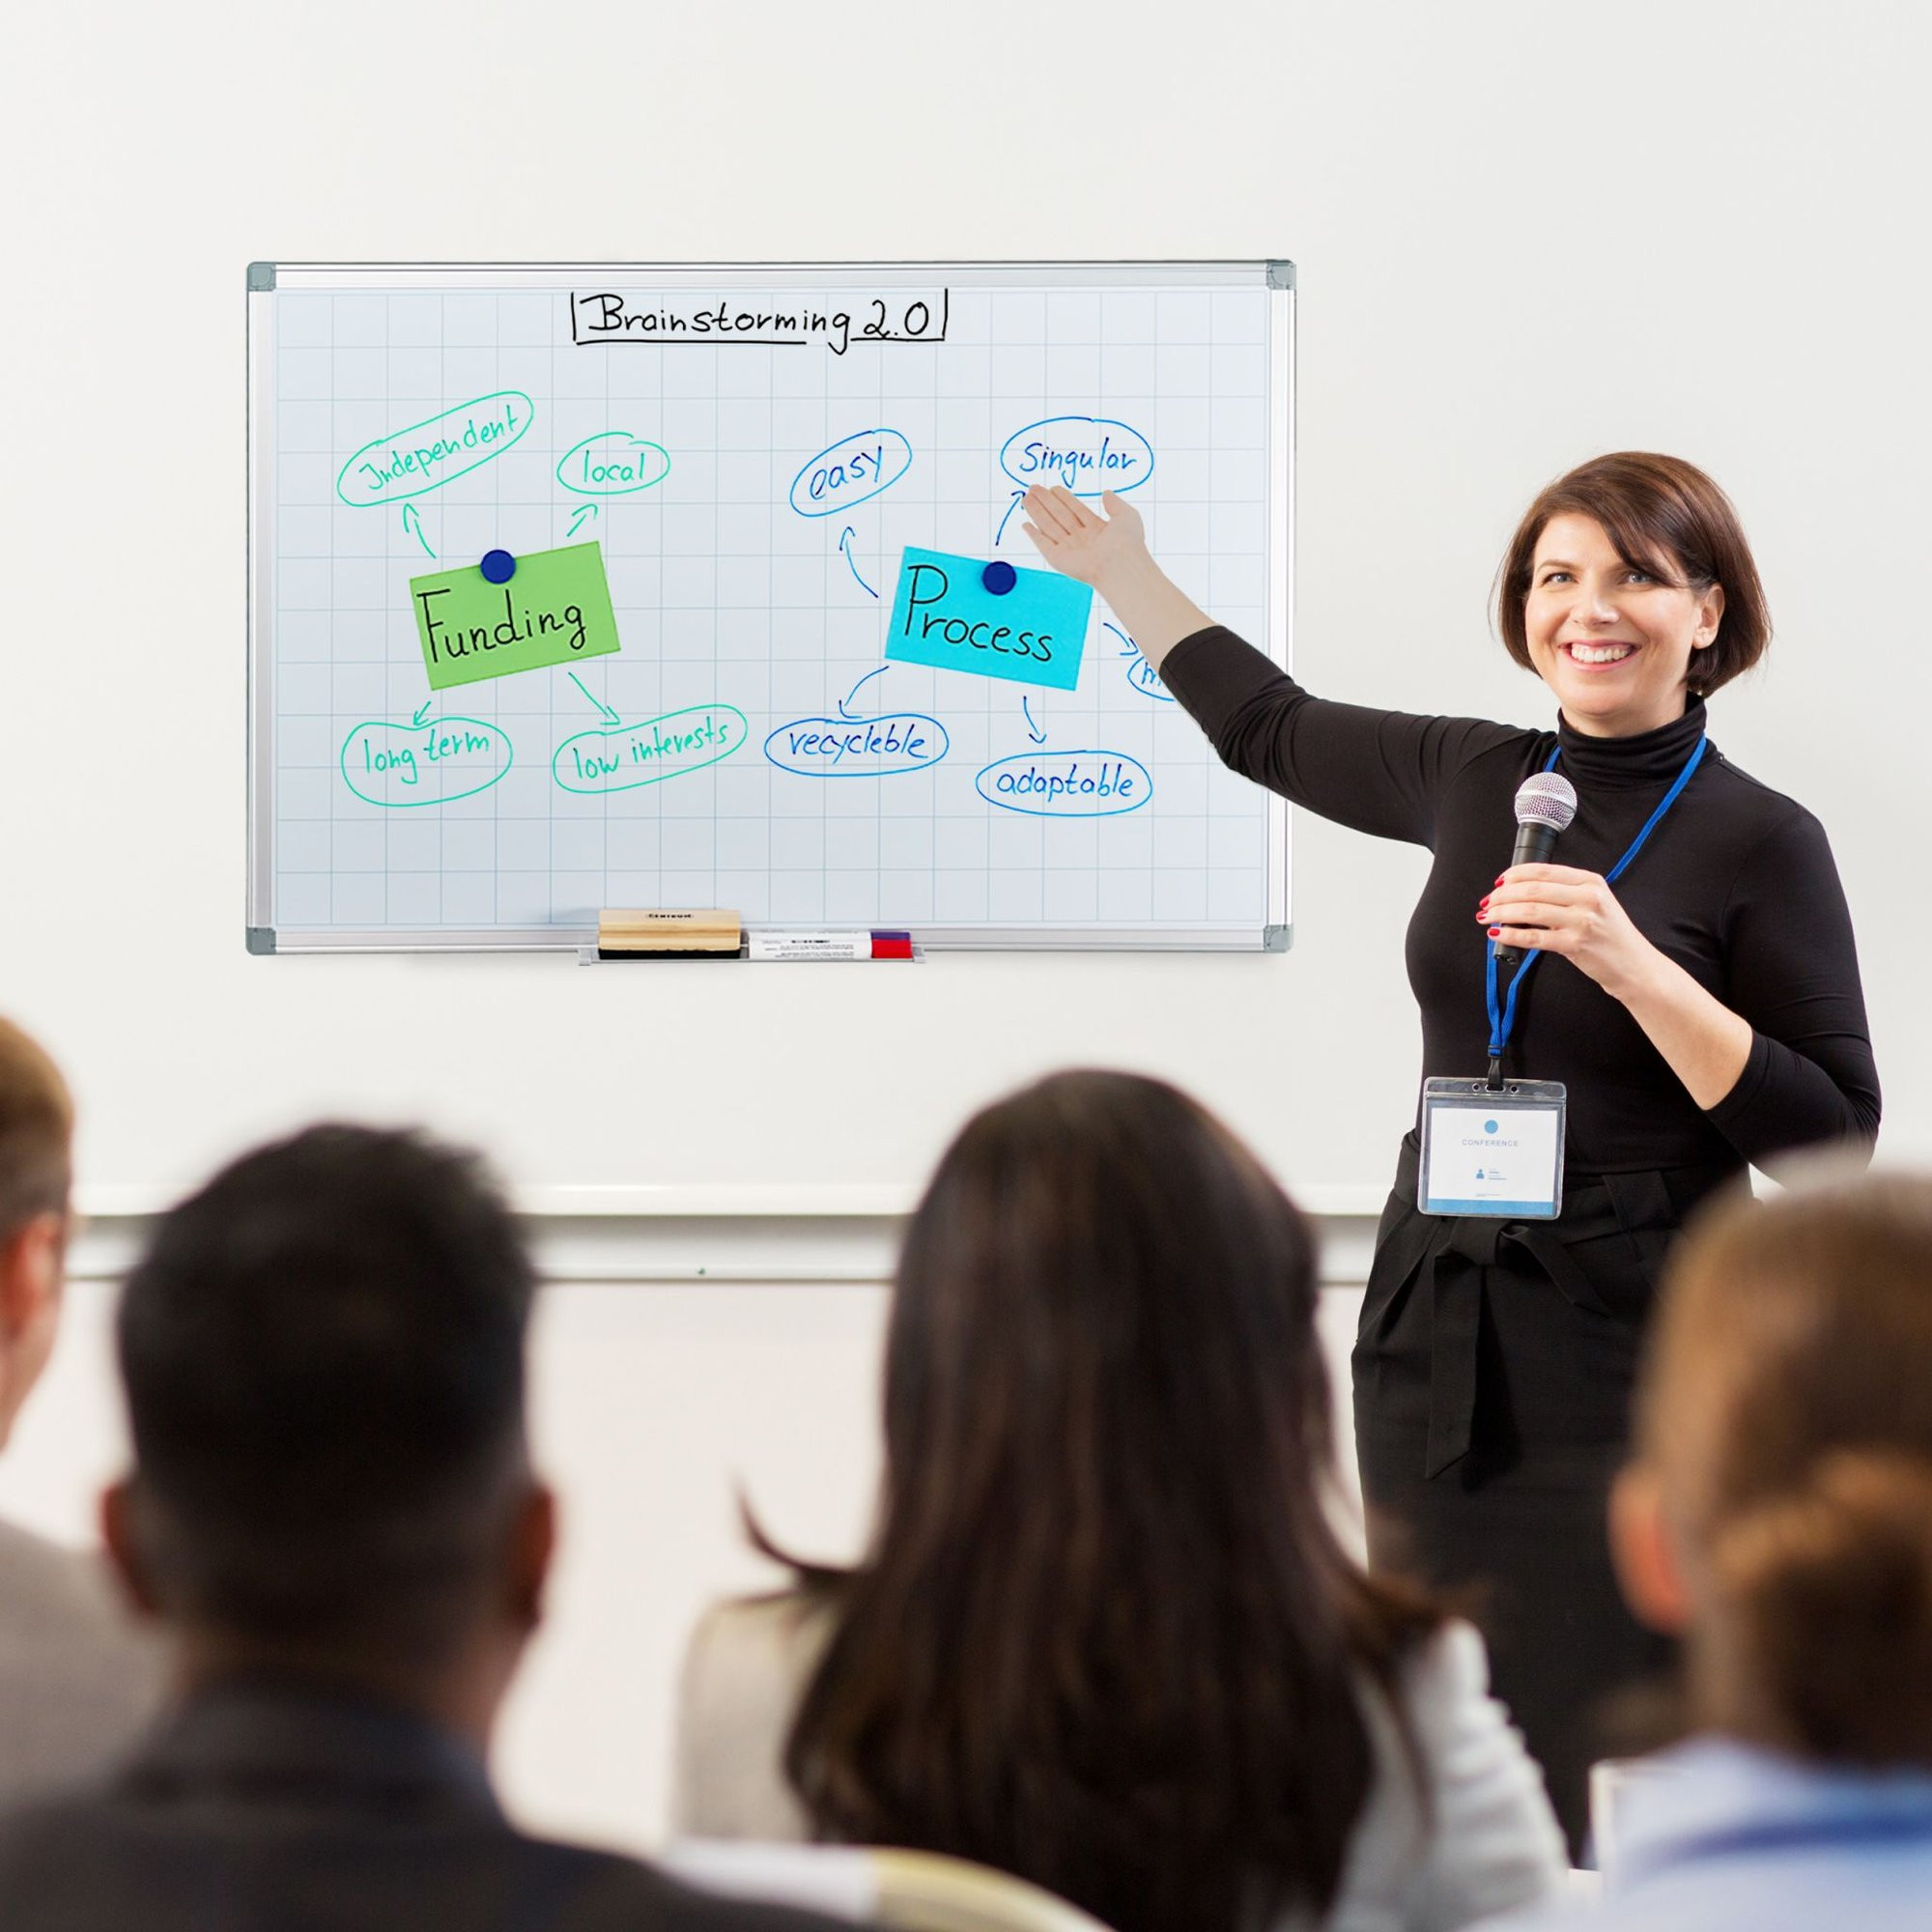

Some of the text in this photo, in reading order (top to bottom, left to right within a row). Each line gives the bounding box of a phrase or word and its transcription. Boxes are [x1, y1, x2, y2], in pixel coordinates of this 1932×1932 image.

[580, 294, 929, 355] Brainstorming 2.0
[583, 449, 645, 483] local
[810, 445, 883, 500] easy
[416, 588, 586, 664] Funding
[904, 564, 1053, 663] Process
[363, 728, 490, 785] long term
[573, 716, 728, 780] low interests
[996, 763, 1134, 803] adaptable
[1462, 1139, 1520, 1148] CONFERENCE
